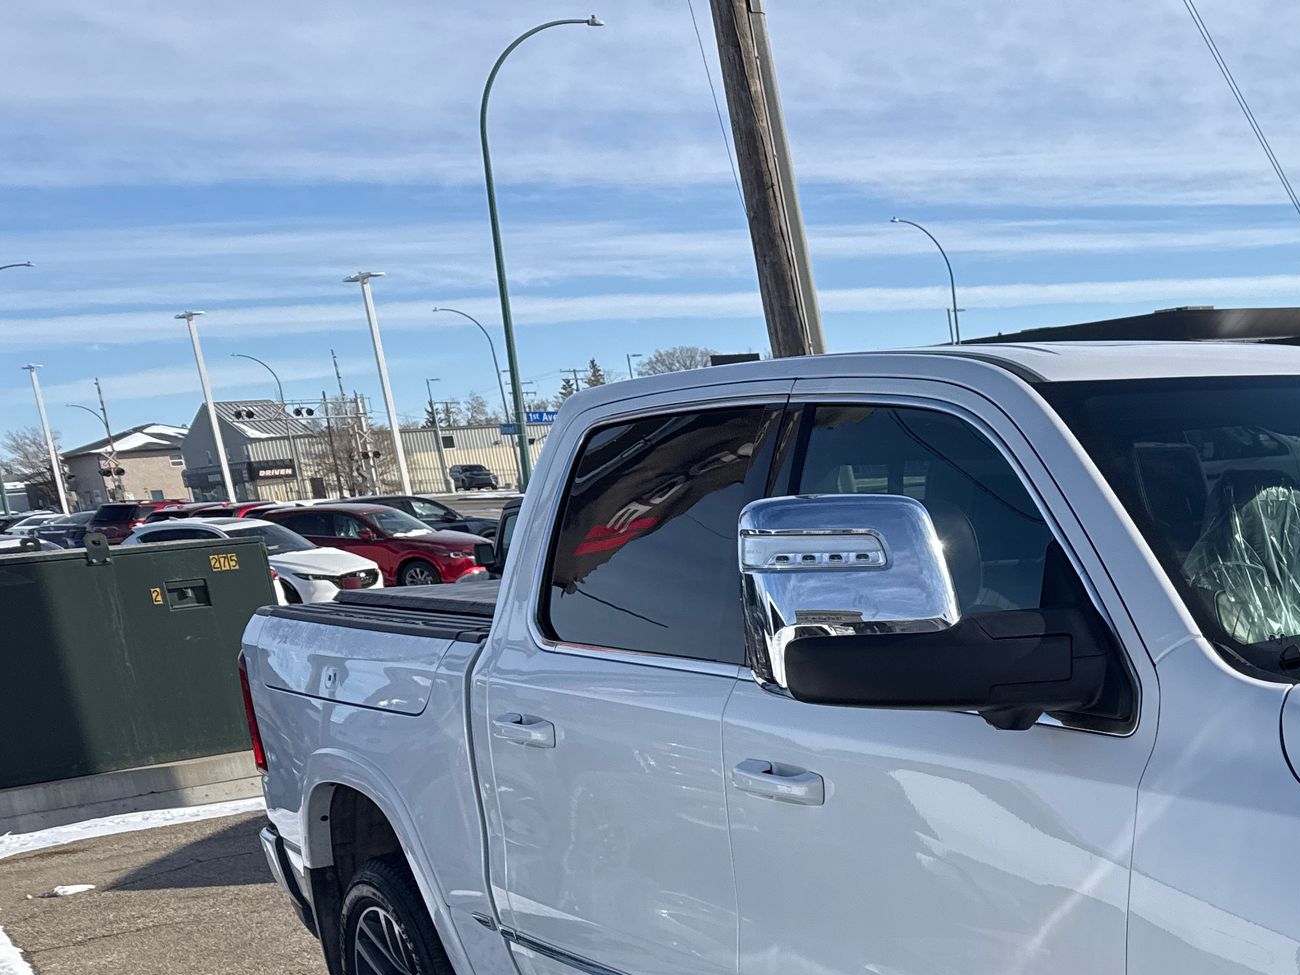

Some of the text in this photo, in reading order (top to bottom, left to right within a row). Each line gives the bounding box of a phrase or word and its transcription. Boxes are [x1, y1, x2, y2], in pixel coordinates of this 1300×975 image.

[529, 412, 540, 422] 1st
[258, 468, 293, 477] DRIVEN
[210, 554, 239, 571] 275
[151, 588, 162, 604] 2
